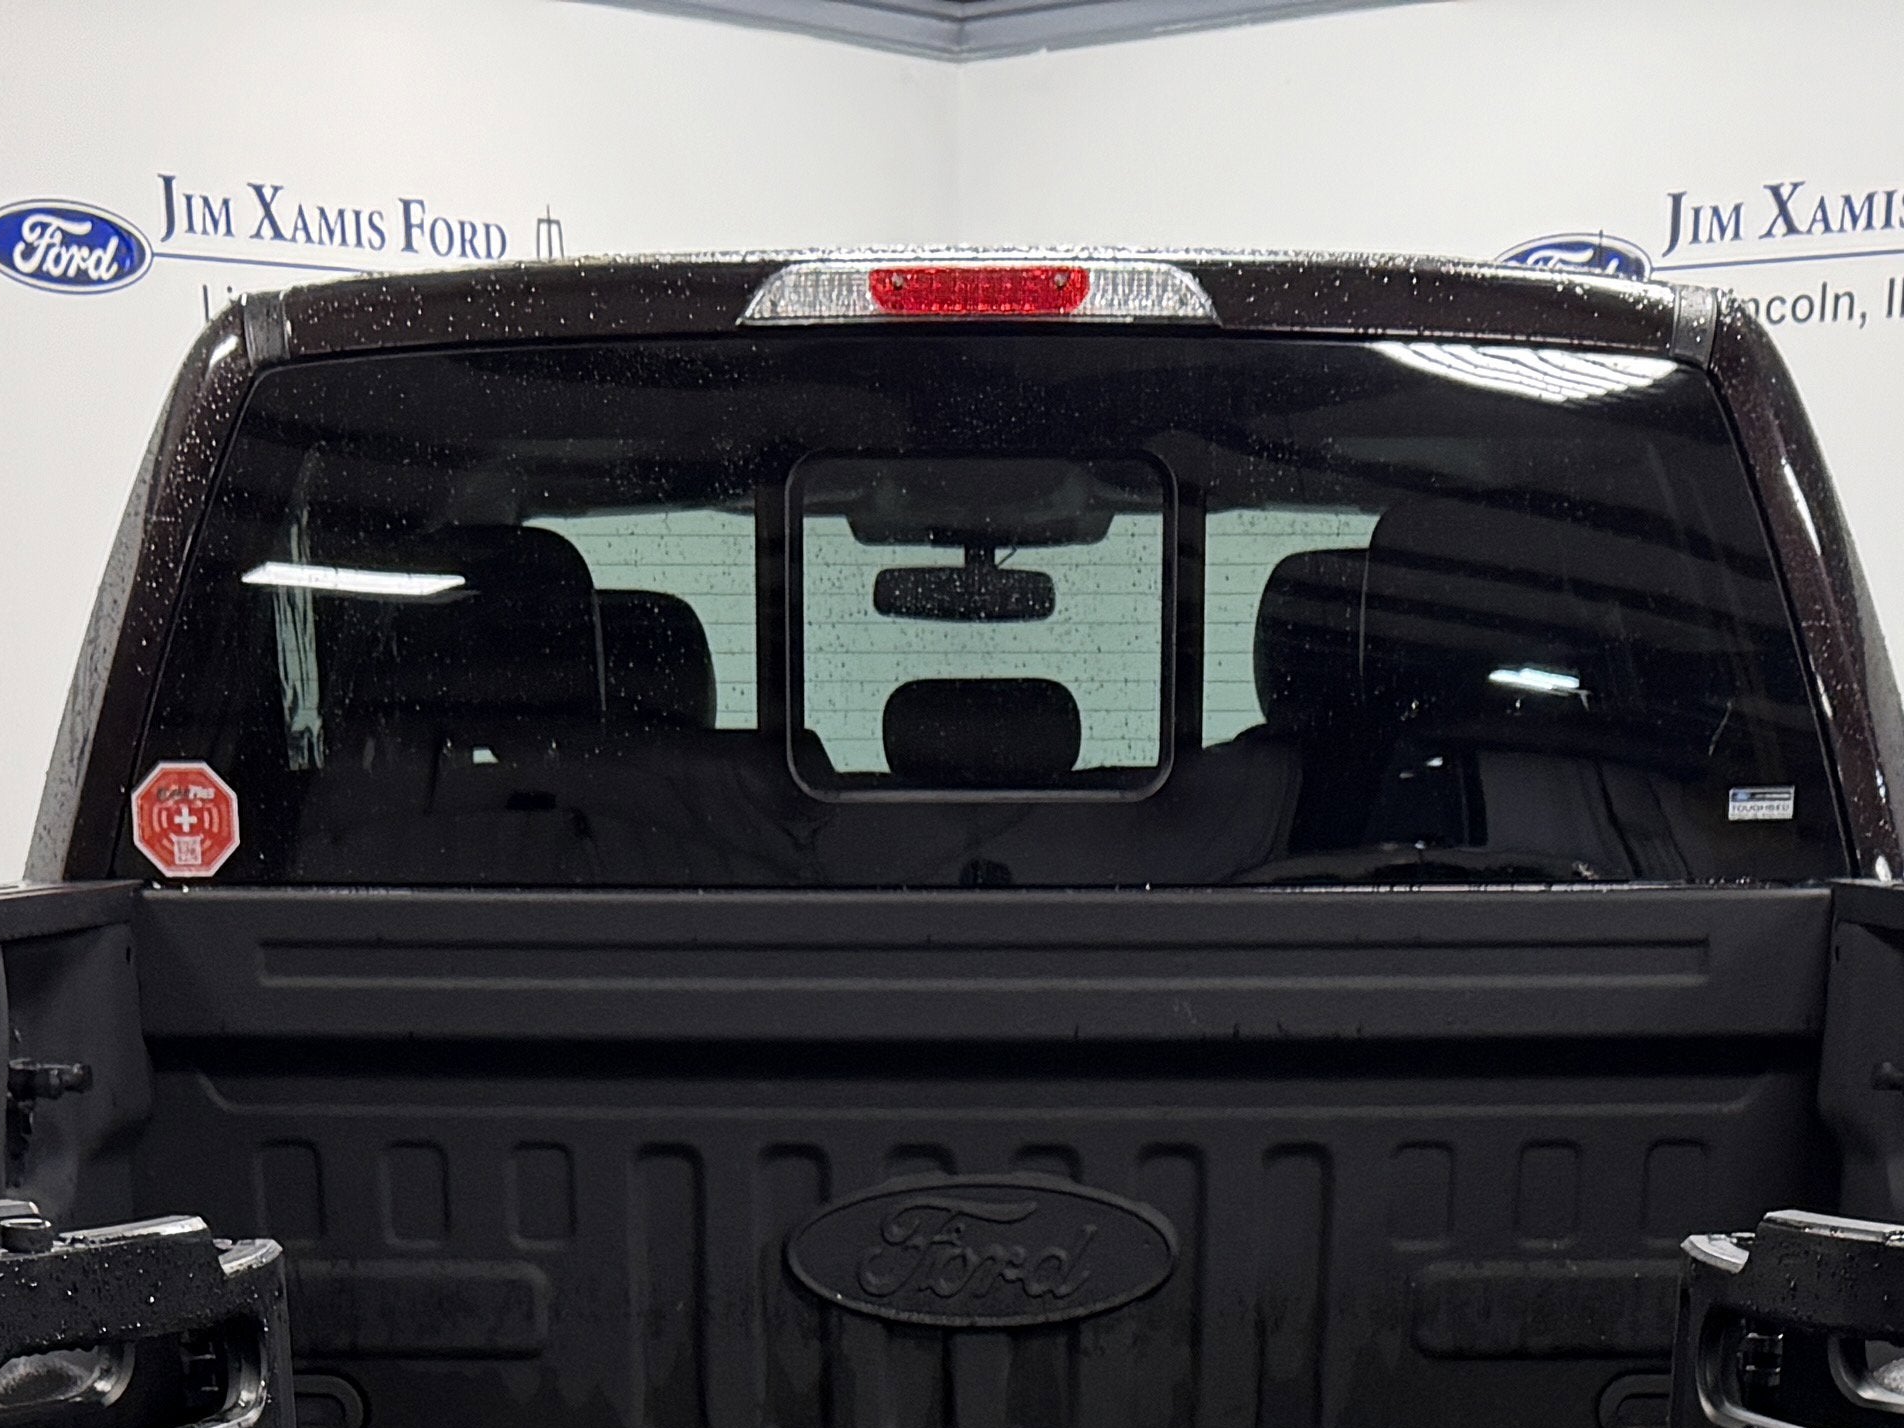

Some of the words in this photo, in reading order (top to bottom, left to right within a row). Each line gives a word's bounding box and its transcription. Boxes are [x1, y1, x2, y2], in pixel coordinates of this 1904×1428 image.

[14, 214, 122, 282] Ford
[158, 173, 234, 243] JIM
[247, 183, 386, 251] XAMIS
[398, 198, 508, 260] FORD
[1662, 190, 1744, 257] JIM
[1740, 281, 1867, 330] ncoln,
[858, 1196, 1098, 1300] Ford
